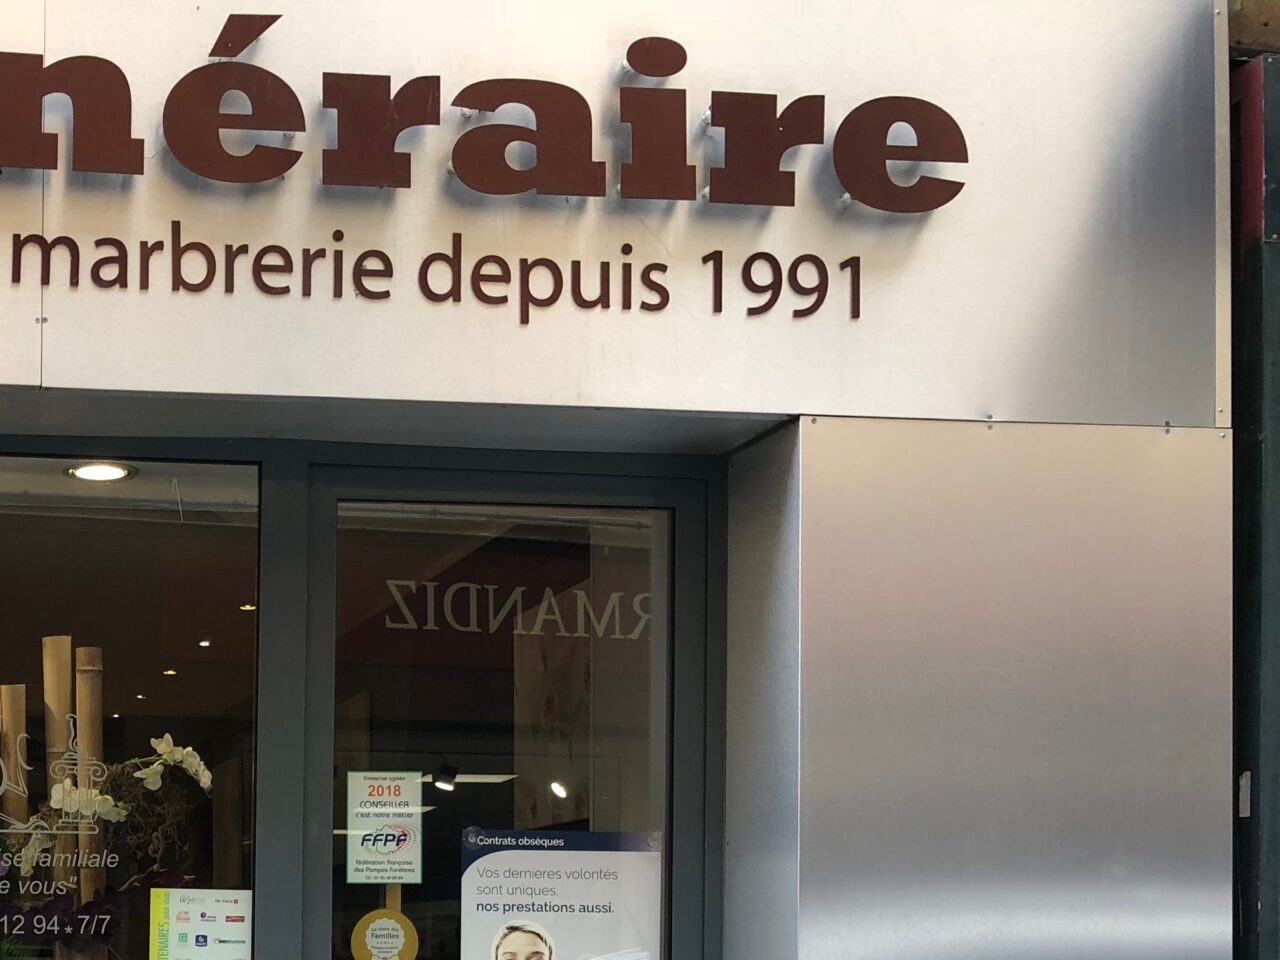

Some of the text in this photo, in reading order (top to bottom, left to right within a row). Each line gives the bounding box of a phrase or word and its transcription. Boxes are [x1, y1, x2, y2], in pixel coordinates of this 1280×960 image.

[11, 221, 393, 300] marbrerie
[418, 233, 670, 325] depuis
[701, 250, 863, 320] 1991
[368, 785, 402, 797] 2018
[360, 800, 410, 809] CONSEILLER
[360, 833, 408, 847] FFPF
[477, 835, 565, 848] Contrats obsèques
[32, 849, 120, 868] familiale
[476, 867, 619, 880] Vos dernières volontés
[476, 885, 503, 895] sont
[476, 901, 615, 914] nos prestations aussi.
[0, 914, 25, 934] 12
